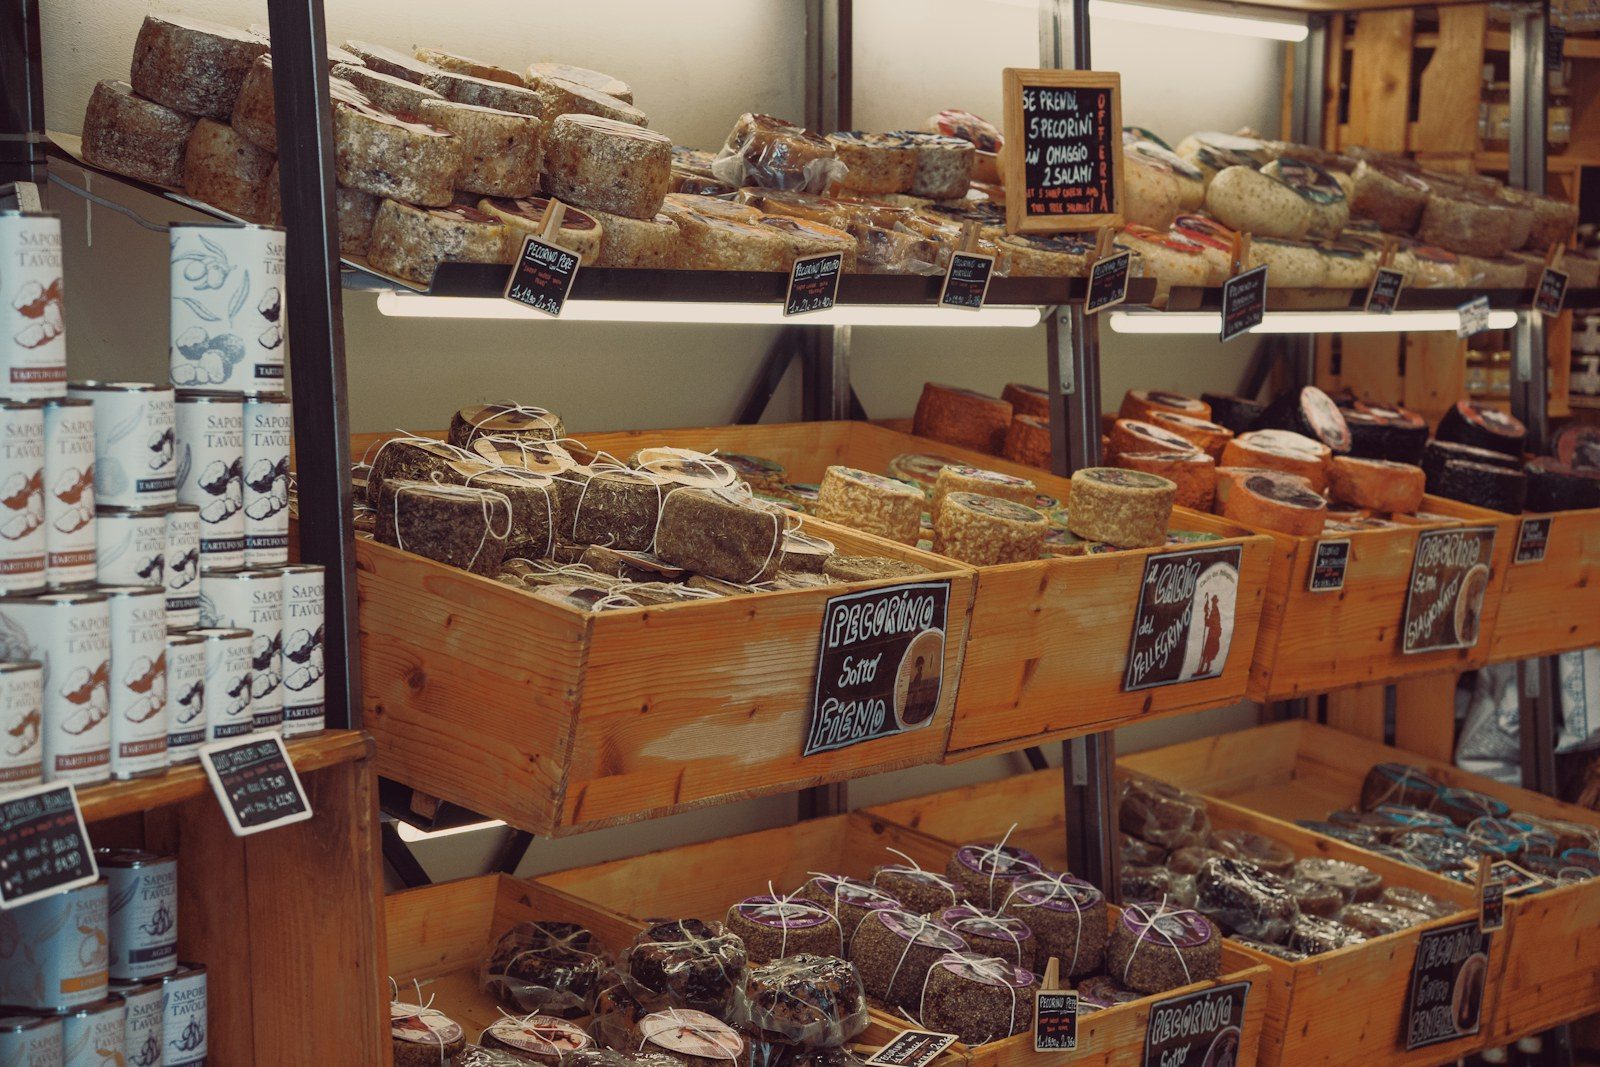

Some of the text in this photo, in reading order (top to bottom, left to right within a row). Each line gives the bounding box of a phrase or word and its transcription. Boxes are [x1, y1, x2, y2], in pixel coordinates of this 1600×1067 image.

[1023, 90, 1036, 111] SE
[1029, 117, 1039, 139] 5
[1098, 93, 1108, 212] OFFERTA
[1042, 167, 1051, 186] 2
[1139, 615, 1154, 636] del
[285, 707, 320, 717] TARTUFO
